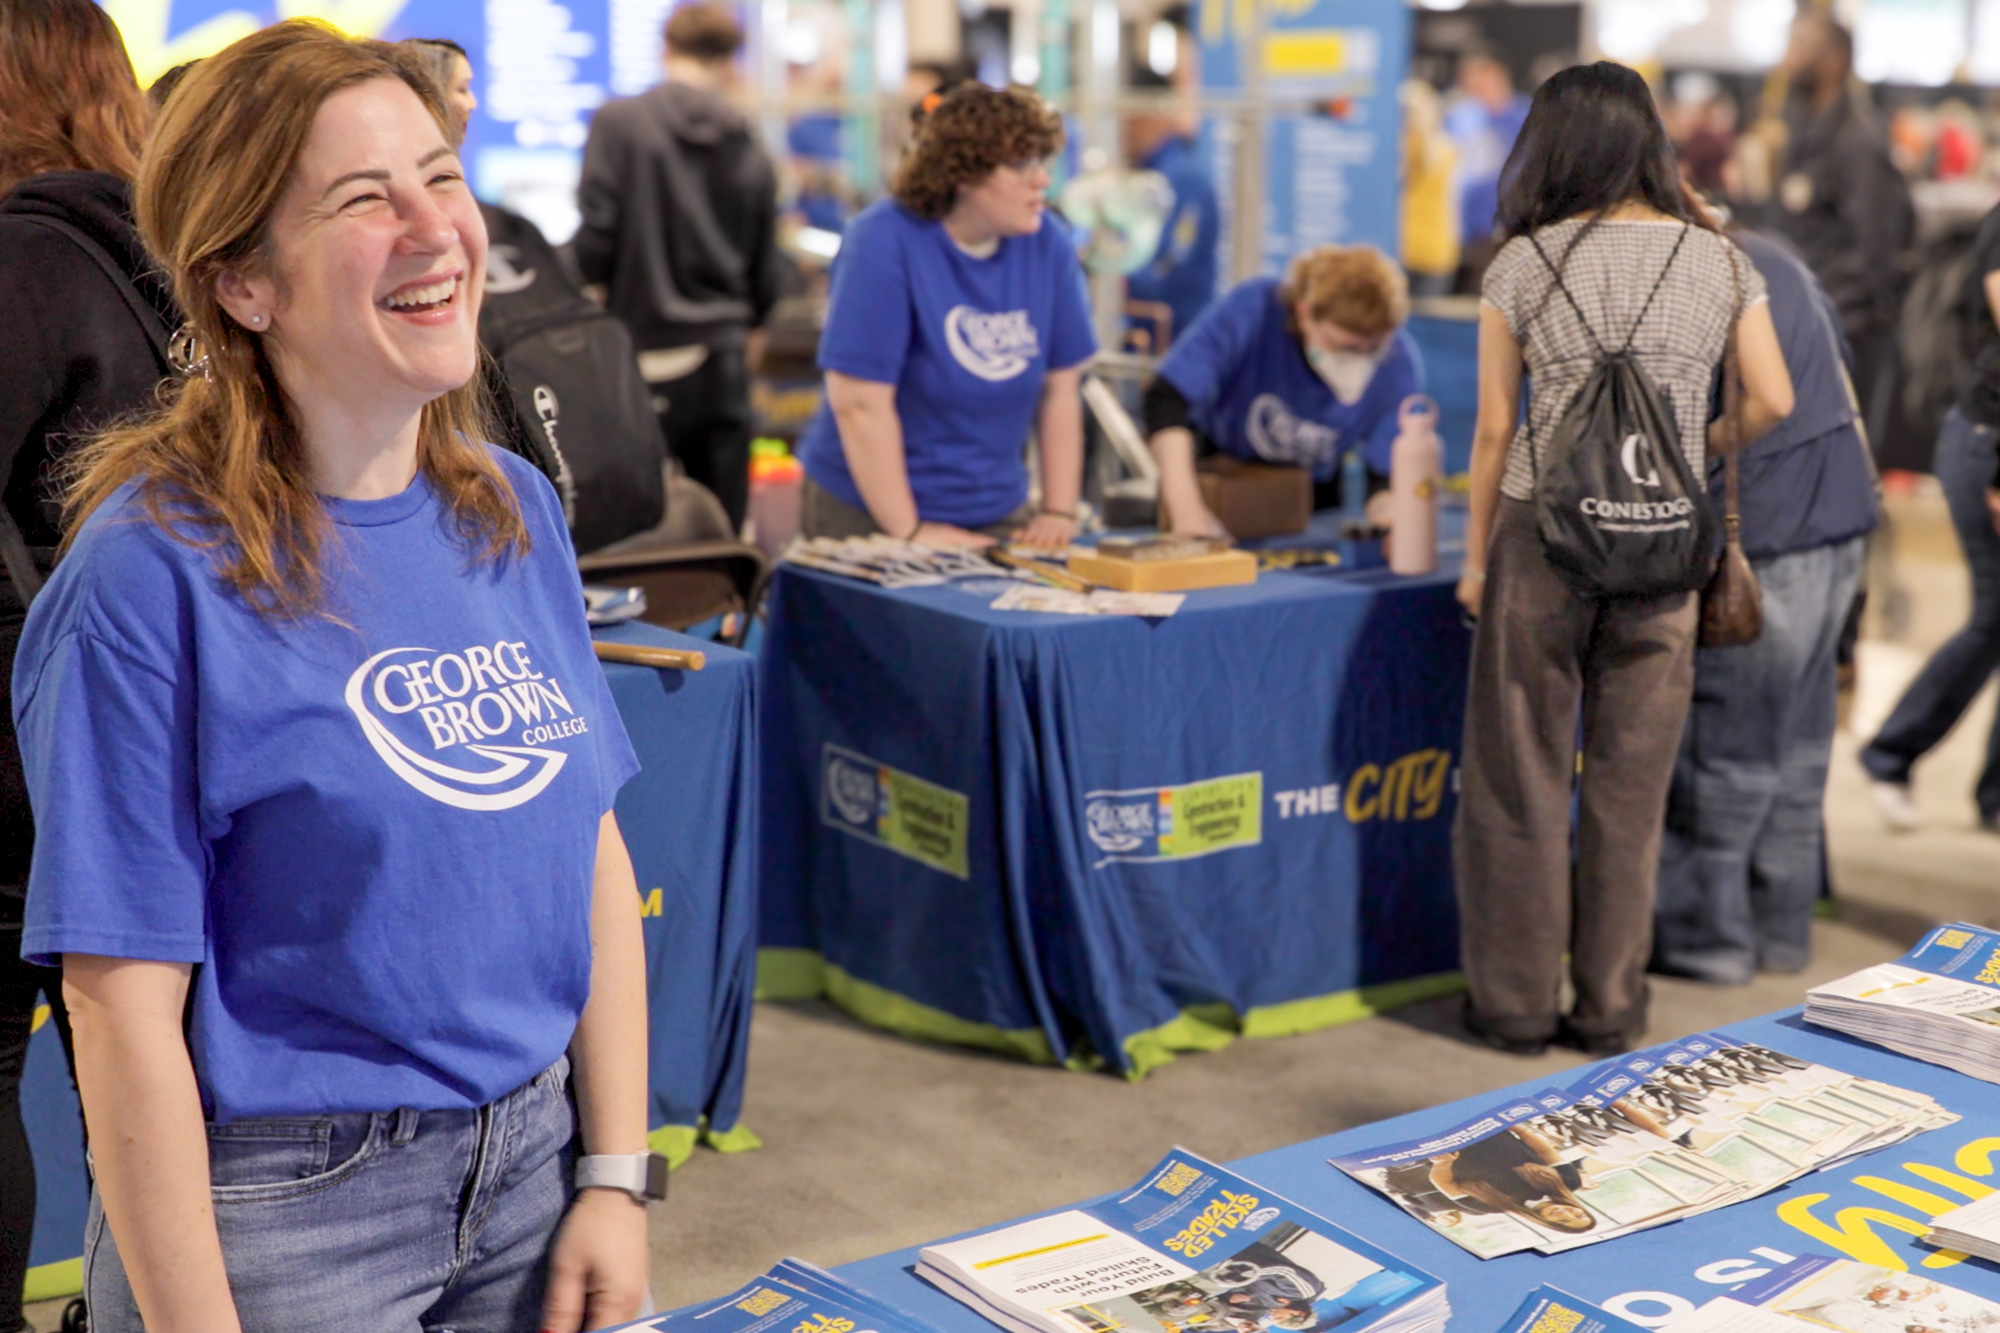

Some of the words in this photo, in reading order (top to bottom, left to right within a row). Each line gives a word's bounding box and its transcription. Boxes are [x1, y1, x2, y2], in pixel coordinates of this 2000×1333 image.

[1579, 498, 1696, 520] CONESTOG
[374, 640, 543, 714] GEORGE
[418, 678, 575, 750] BROWN
[521, 716, 589, 747] COLLEGE
[1273, 783, 1341, 819] THE
[1343, 748, 1451, 823] CITY
[1163, 1189, 1239, 1252] TRADES
[1183, 1193, 1259, 1258] SKILLED
[1085, 1255, 1152, 1277] Skilled
[1097, 1262, 1164, 1283] Future
[1125, 1268, 1176, 1286] Build
[1016, 1273, 1083, 1295] Trades
[1053, 1279, 1095, 1295] with
[1080, 1282, 1124, 1299] Your
